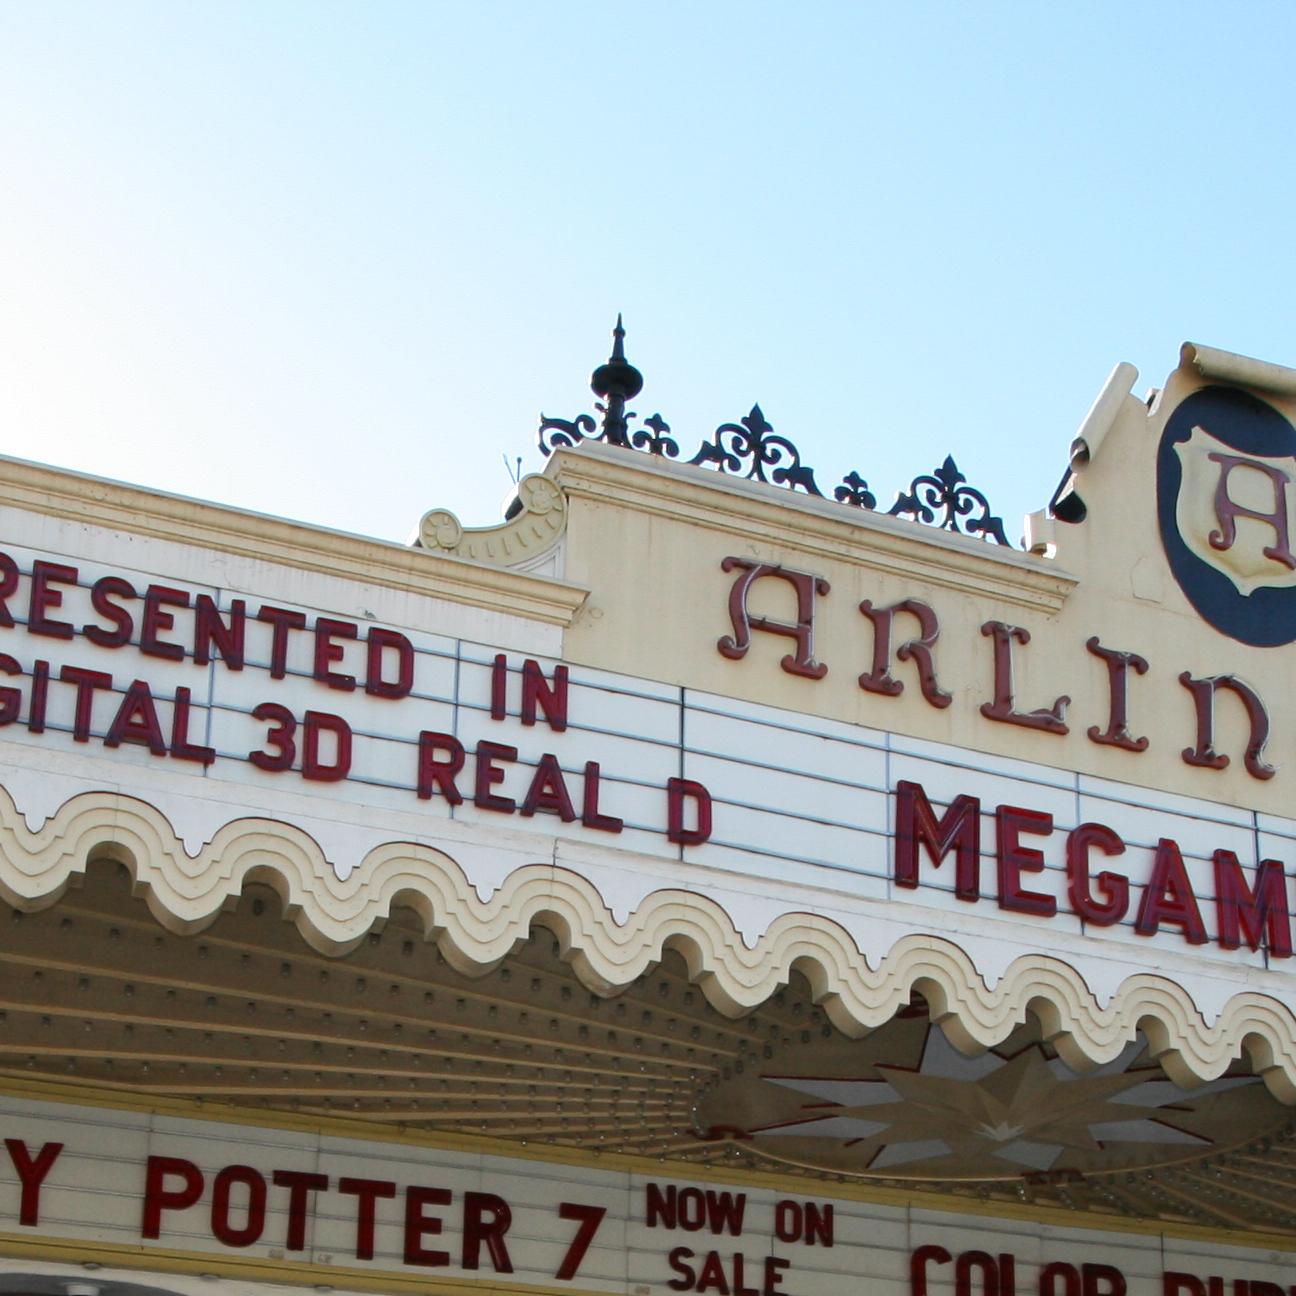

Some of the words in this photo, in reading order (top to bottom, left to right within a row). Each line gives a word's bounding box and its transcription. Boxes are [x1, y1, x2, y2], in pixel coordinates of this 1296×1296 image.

[491, 653, 569, 732] IN
[248, 703, 353, 784] 3D
[417, 729, 624, 834] REAL
[666, 777, 714, 846] D
[141, 1154, 514, 1275] POTTER
[554, 1202, 607, 1281] 7
[646, 1183, 746, 1236] NOW
[775, 1200, 833, 1247] ON
